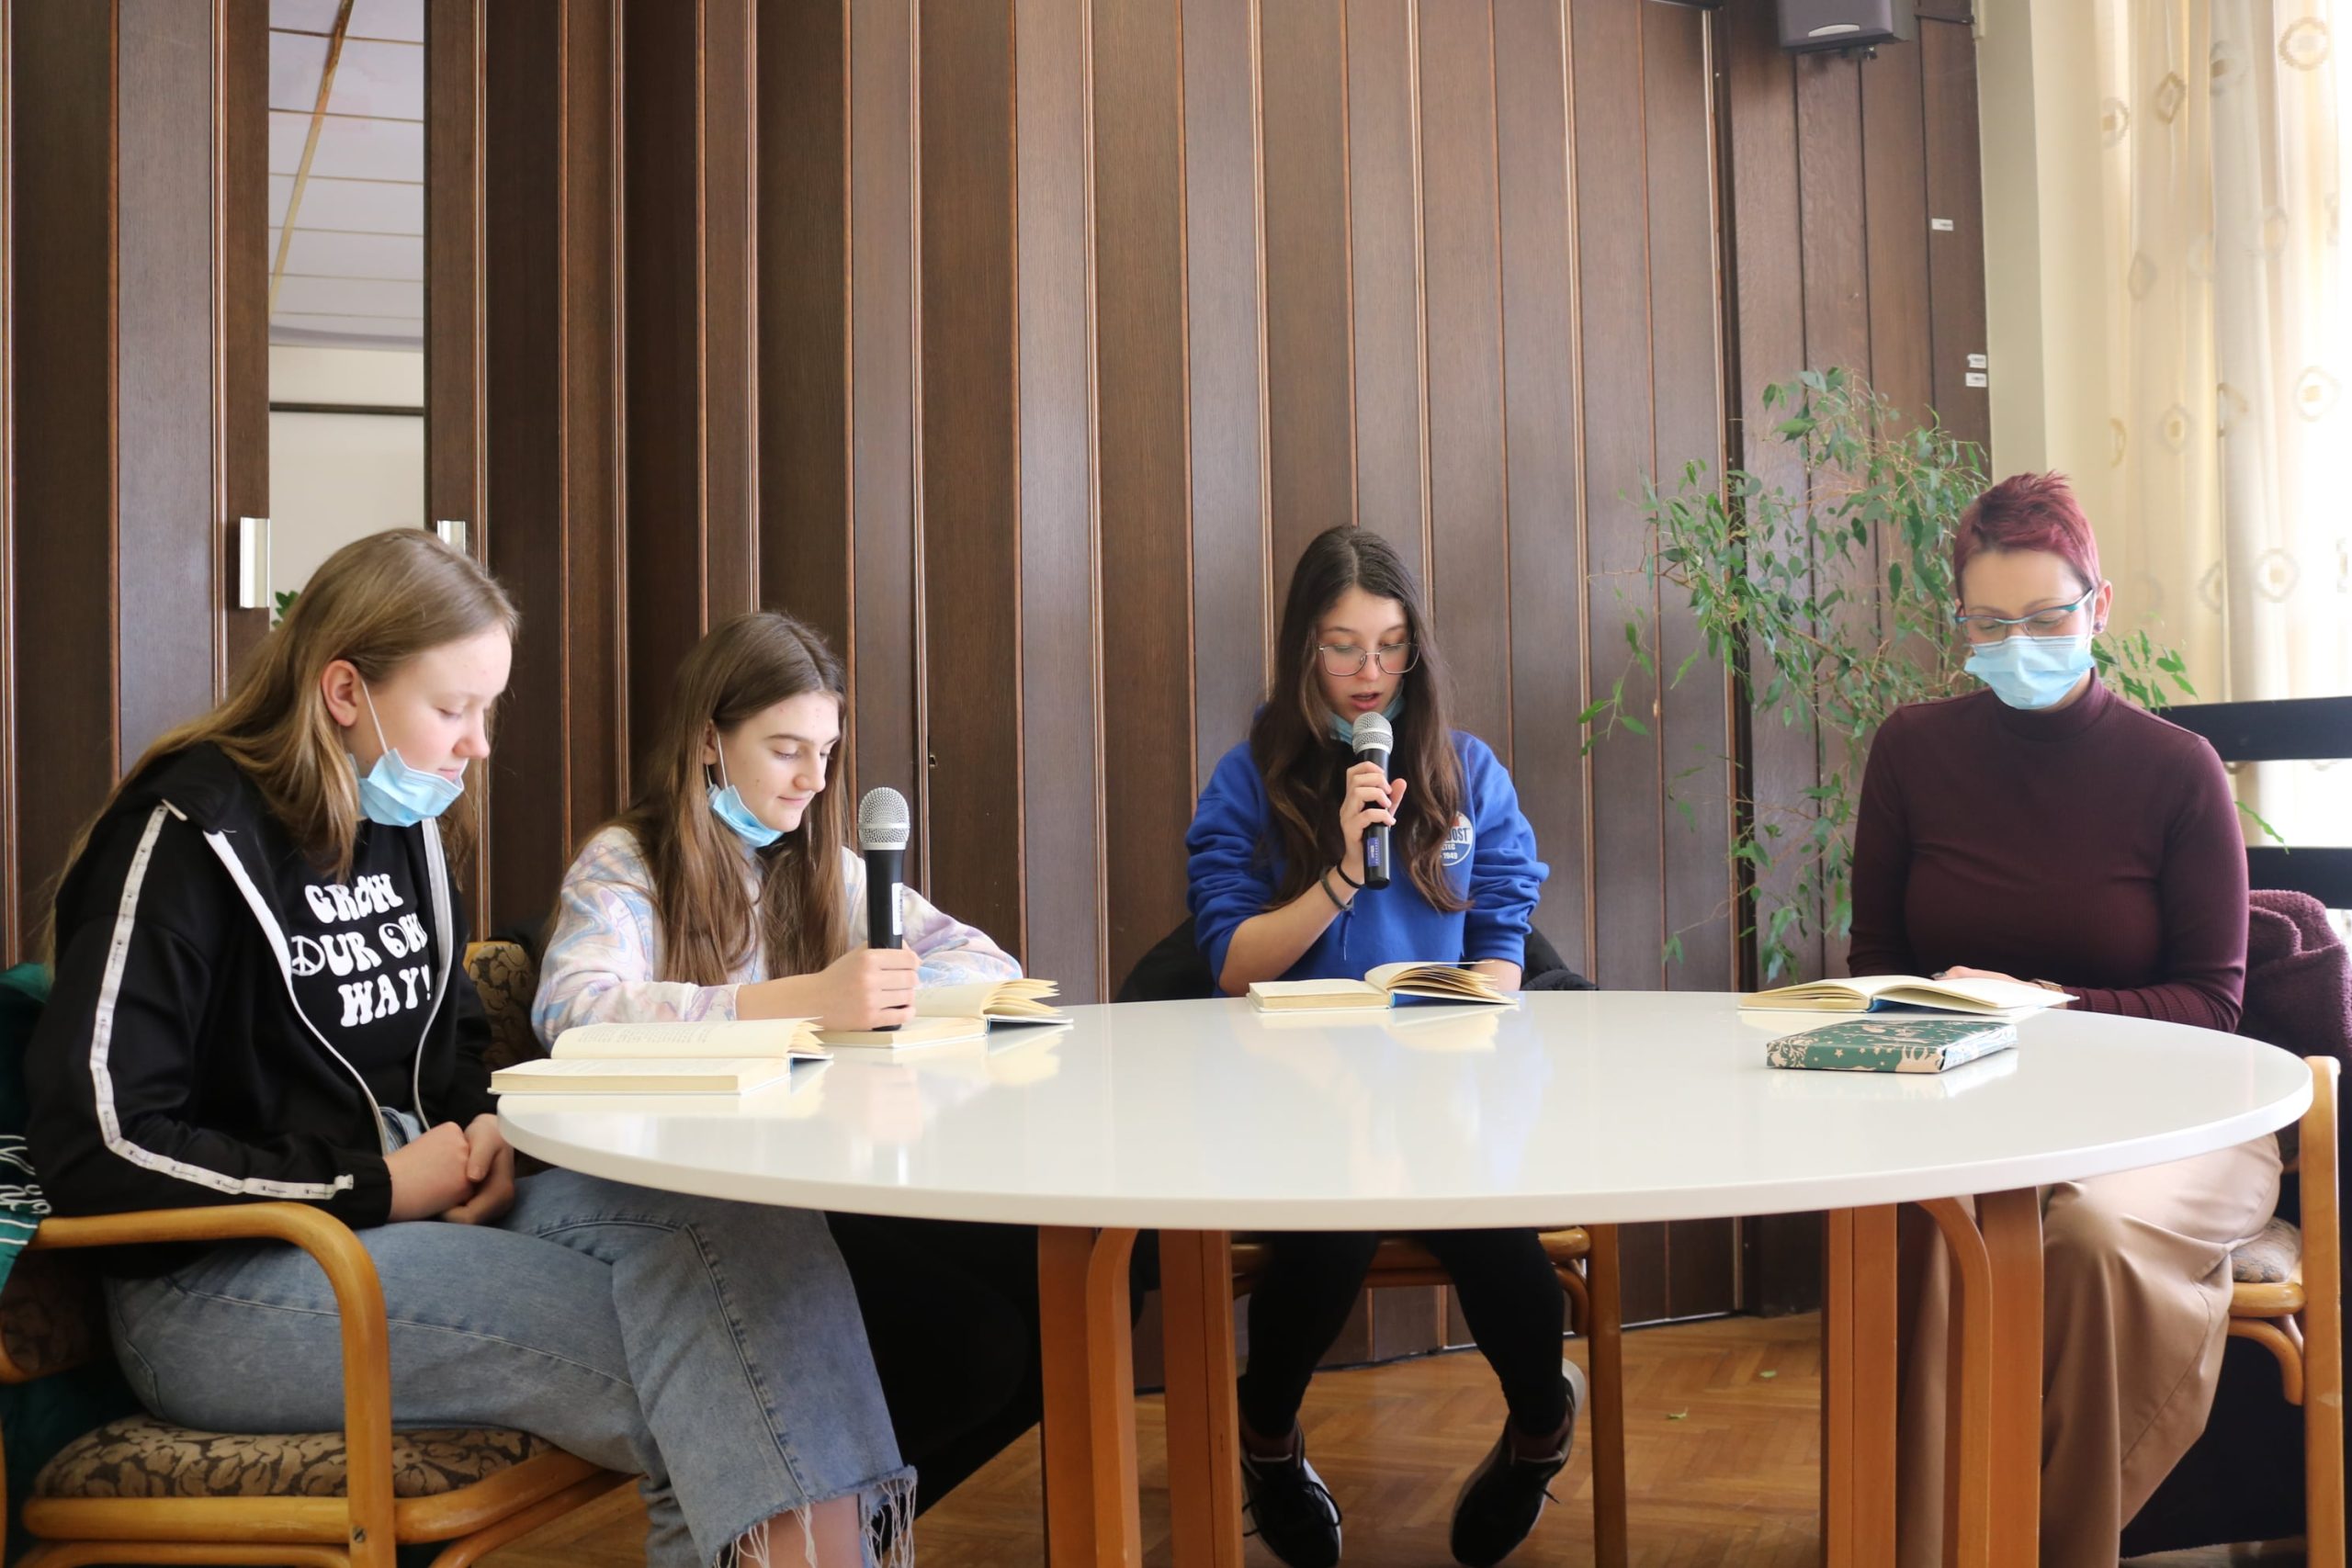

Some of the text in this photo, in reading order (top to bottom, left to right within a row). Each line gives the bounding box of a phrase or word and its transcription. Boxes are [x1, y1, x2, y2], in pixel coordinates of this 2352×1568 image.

[304, 873, 404, 924] GROW
[379, 912, 428, 959] OW
[337, 964, 432, 1028] WAY!
